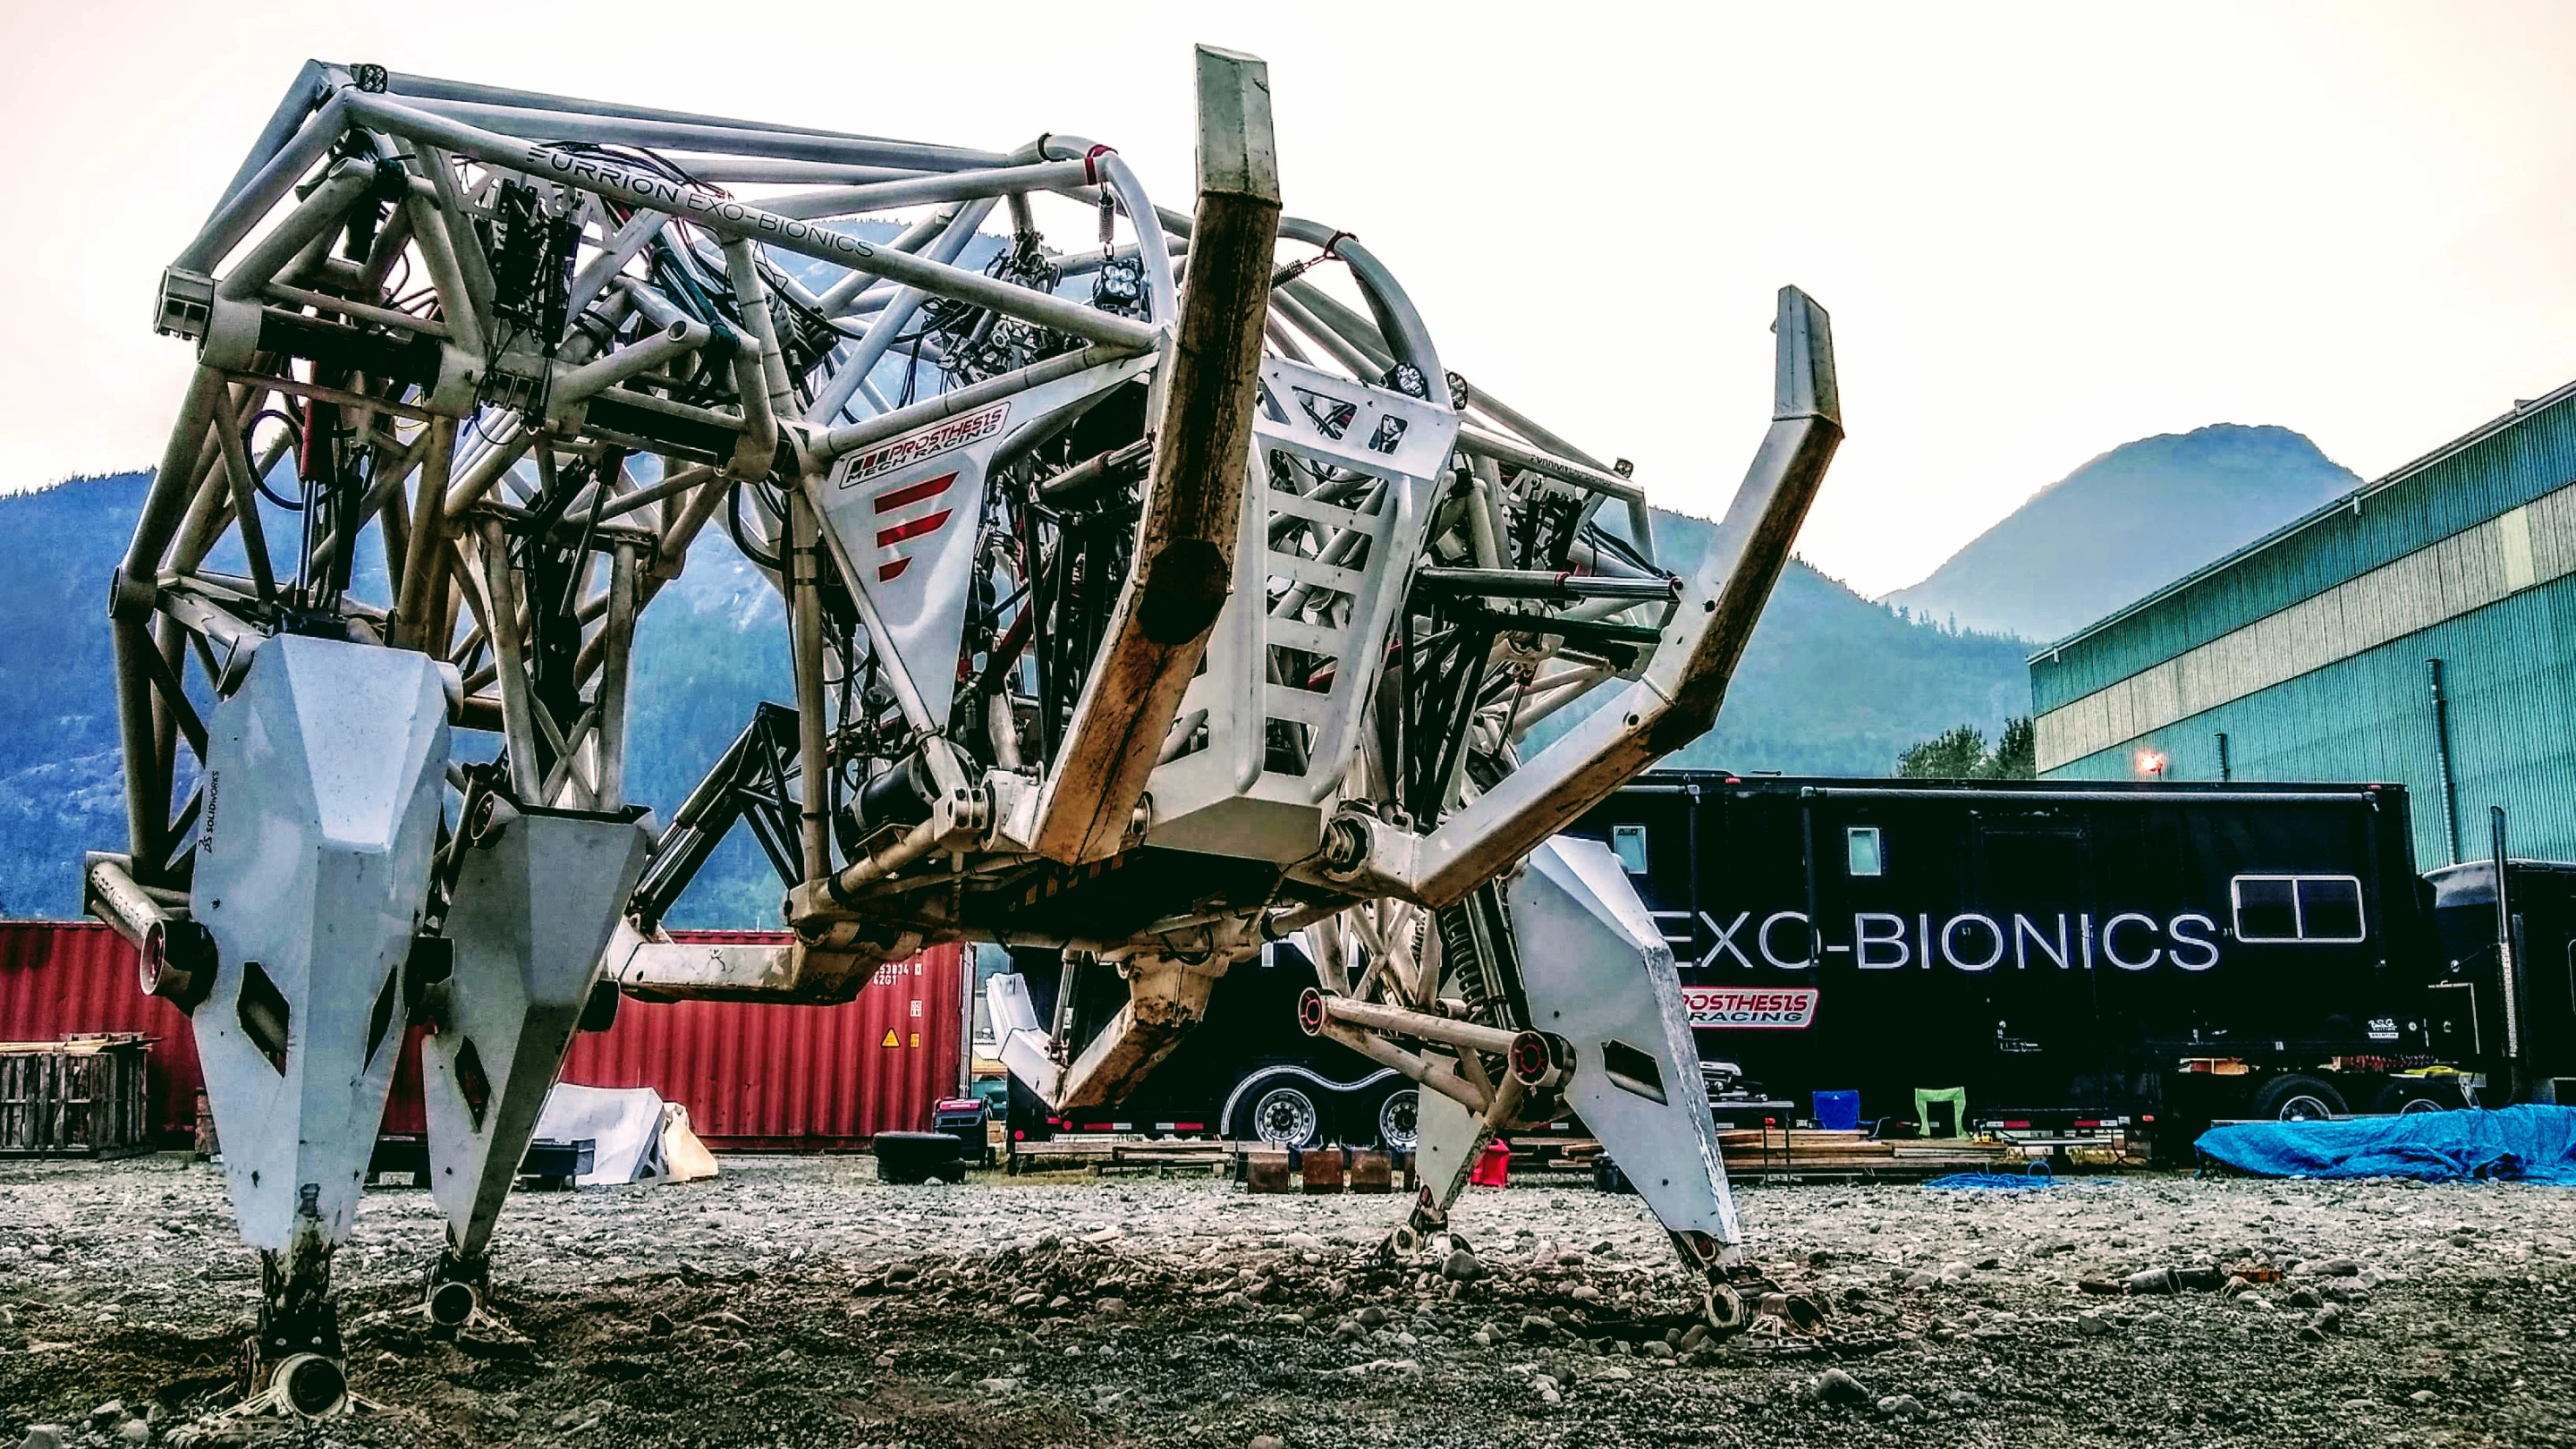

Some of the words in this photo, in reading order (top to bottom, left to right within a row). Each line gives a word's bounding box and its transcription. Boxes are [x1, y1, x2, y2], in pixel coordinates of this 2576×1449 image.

[526, 147, 679, 204] FURRION
[687, 192, 875, 258] EXO-BIONICS
[845, 454, 907, 484] MECH
[912, 423, 997, 461] RACING
[206, 770, 220, 834] SOLIDWORKS
[875, 963, 910, 975] 53834
[1648, 911, 2219, 971] EXO-BIONICS
[1681, 994, 1809, 1012] OSTHESIS
[1688, 1011, 1803, 1021] RACING
